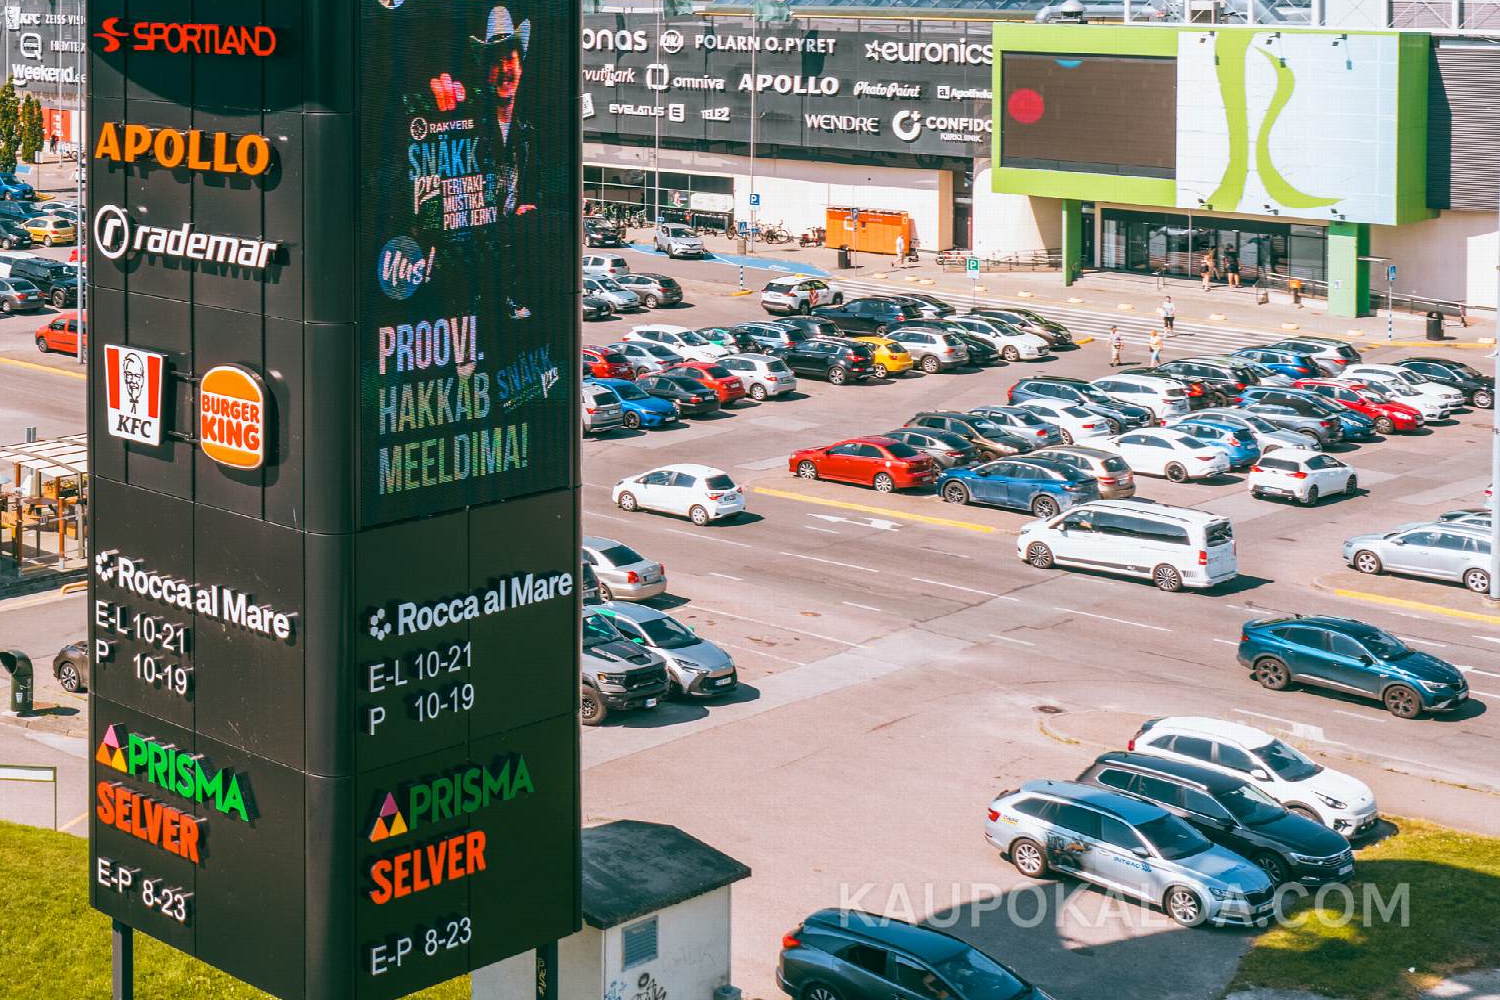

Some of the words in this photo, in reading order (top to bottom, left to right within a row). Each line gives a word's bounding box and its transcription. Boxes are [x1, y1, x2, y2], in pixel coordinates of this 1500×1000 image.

[20, 13, 41, 25] KFC
[45, 14, 66, 25] ZEISS
[133, 21, 277, 57] SPORTLAND
[695, 34, 760, 51] POLARN
[764, 36, 783, 51] O.
[785, 38, 836, 54] PYRET
[882, 37, 993, 65] euronics
[673, 74, 725, 90] omniva
[738, 73, 839, 95] APOLLO
[430, 119, 474, 133] RAKVERE
[609, 104, 665, 116] EVELATUS
[701, 107, 730, 121] TELE2
[805, 114, 879, 133] WENDRE
[94, 121, 270, 176] APOLLO
[408, 135, 480, 180] SNÄKK
[134, 218, 277, 270] rademar
[443, 210, 469, 231] PORK
[470, 206, 498, 227] JERKY
[379, 314, 484, 374] PROOVI.
[116, 413, 152, 438] KFC
[201, 394, 259, 424] BURGER
[380, 370, 490, 434] HAKKAB
[201, 419, 260, 449] KING
[380, 422, 529, 494] MEELDIMA!
[119, 556, 192, 608] Rocca
[195, 585, 220, 616] al
[222, 592, 290, 639] Mare
[397, 589, 479, 635] Rocca
[484, 580, 506, 612] al
[511, 571, 573, 608] Mare
[95, 600, 128, 636] E-L
[133, 612, 186, 654] 10-21
[95, 640, 109, 664] P
[133, 654, 187, 695] 10-19
[369, 658, 408, 693] E-L
[414, 641, 472, 682] 10-21
[369, 706, 386, 735] P
[414, 683, 475, 723] 10-19
[127, 733, 248, 822] PRISMA
[410, 754, 535, 832] PRISMA
[97, 781, 199, 864] SELVER
[97, 857, 132, 894] E-P
[143, 879, 187, 922] 8-23
[370, 829, 486, 905] SELVER
[372, 936, 412, 977] E-P
[424, 916, 472, 957] 8-23
